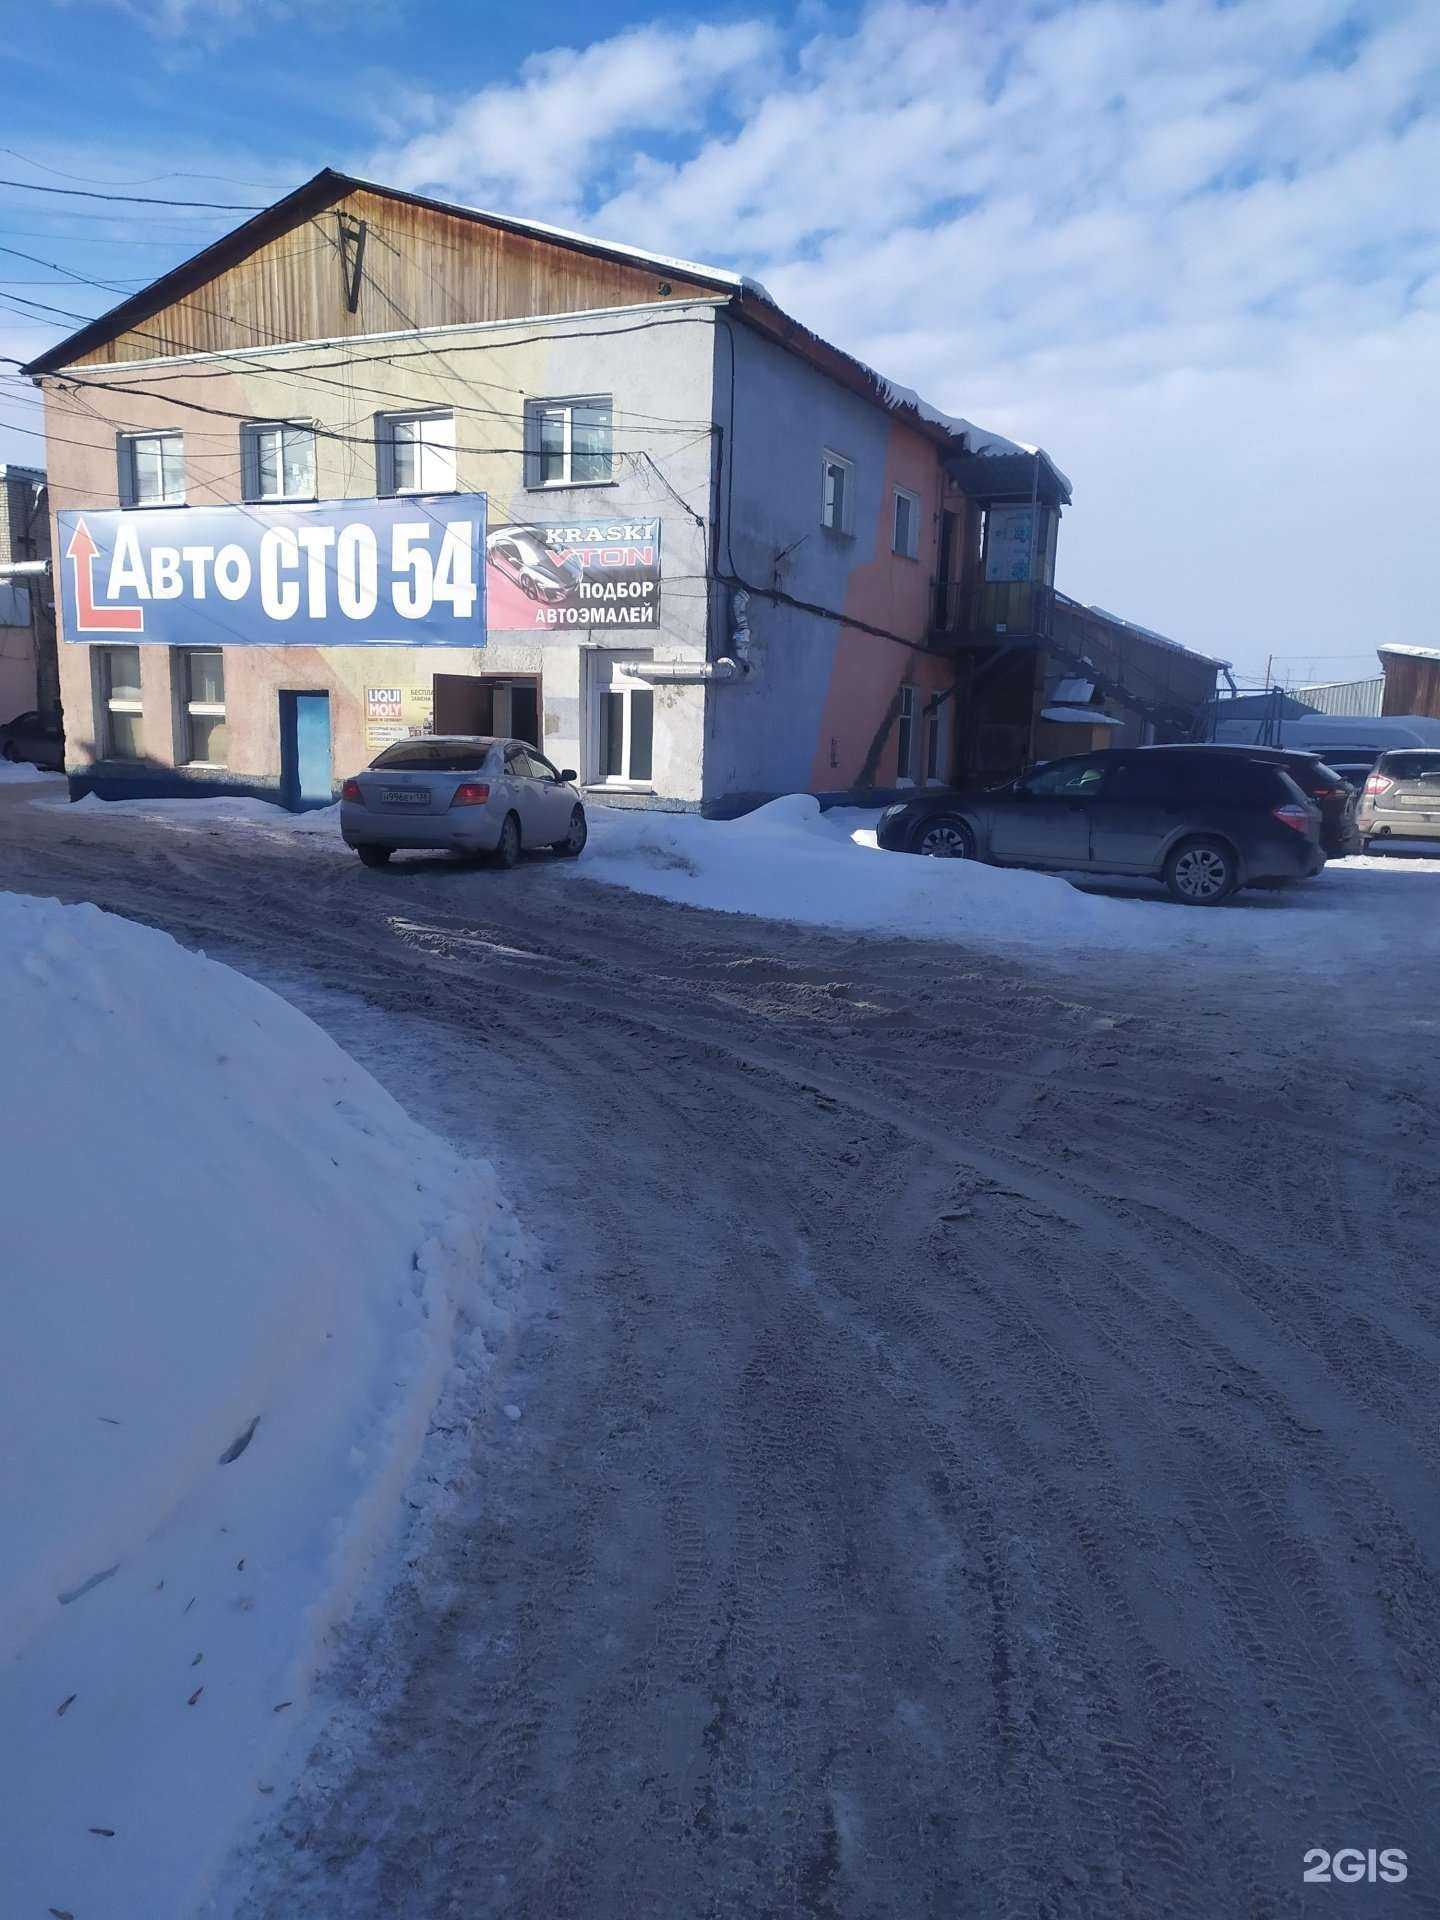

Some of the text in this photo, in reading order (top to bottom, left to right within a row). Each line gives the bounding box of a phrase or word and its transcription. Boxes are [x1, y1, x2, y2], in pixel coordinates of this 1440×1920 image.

[545, 525, 653, 543] KRASKI
[260, 524, 378, 621] СТО
[391, 521, 477, 618] 54
[579, 582, 654, 600] ПОДБОР
[535, 602, 653, 624] АВТОЭМАЛЕЙ
[368, 689, 400, 702] LIQUI
[368, 703, 401, 716] MOLY
